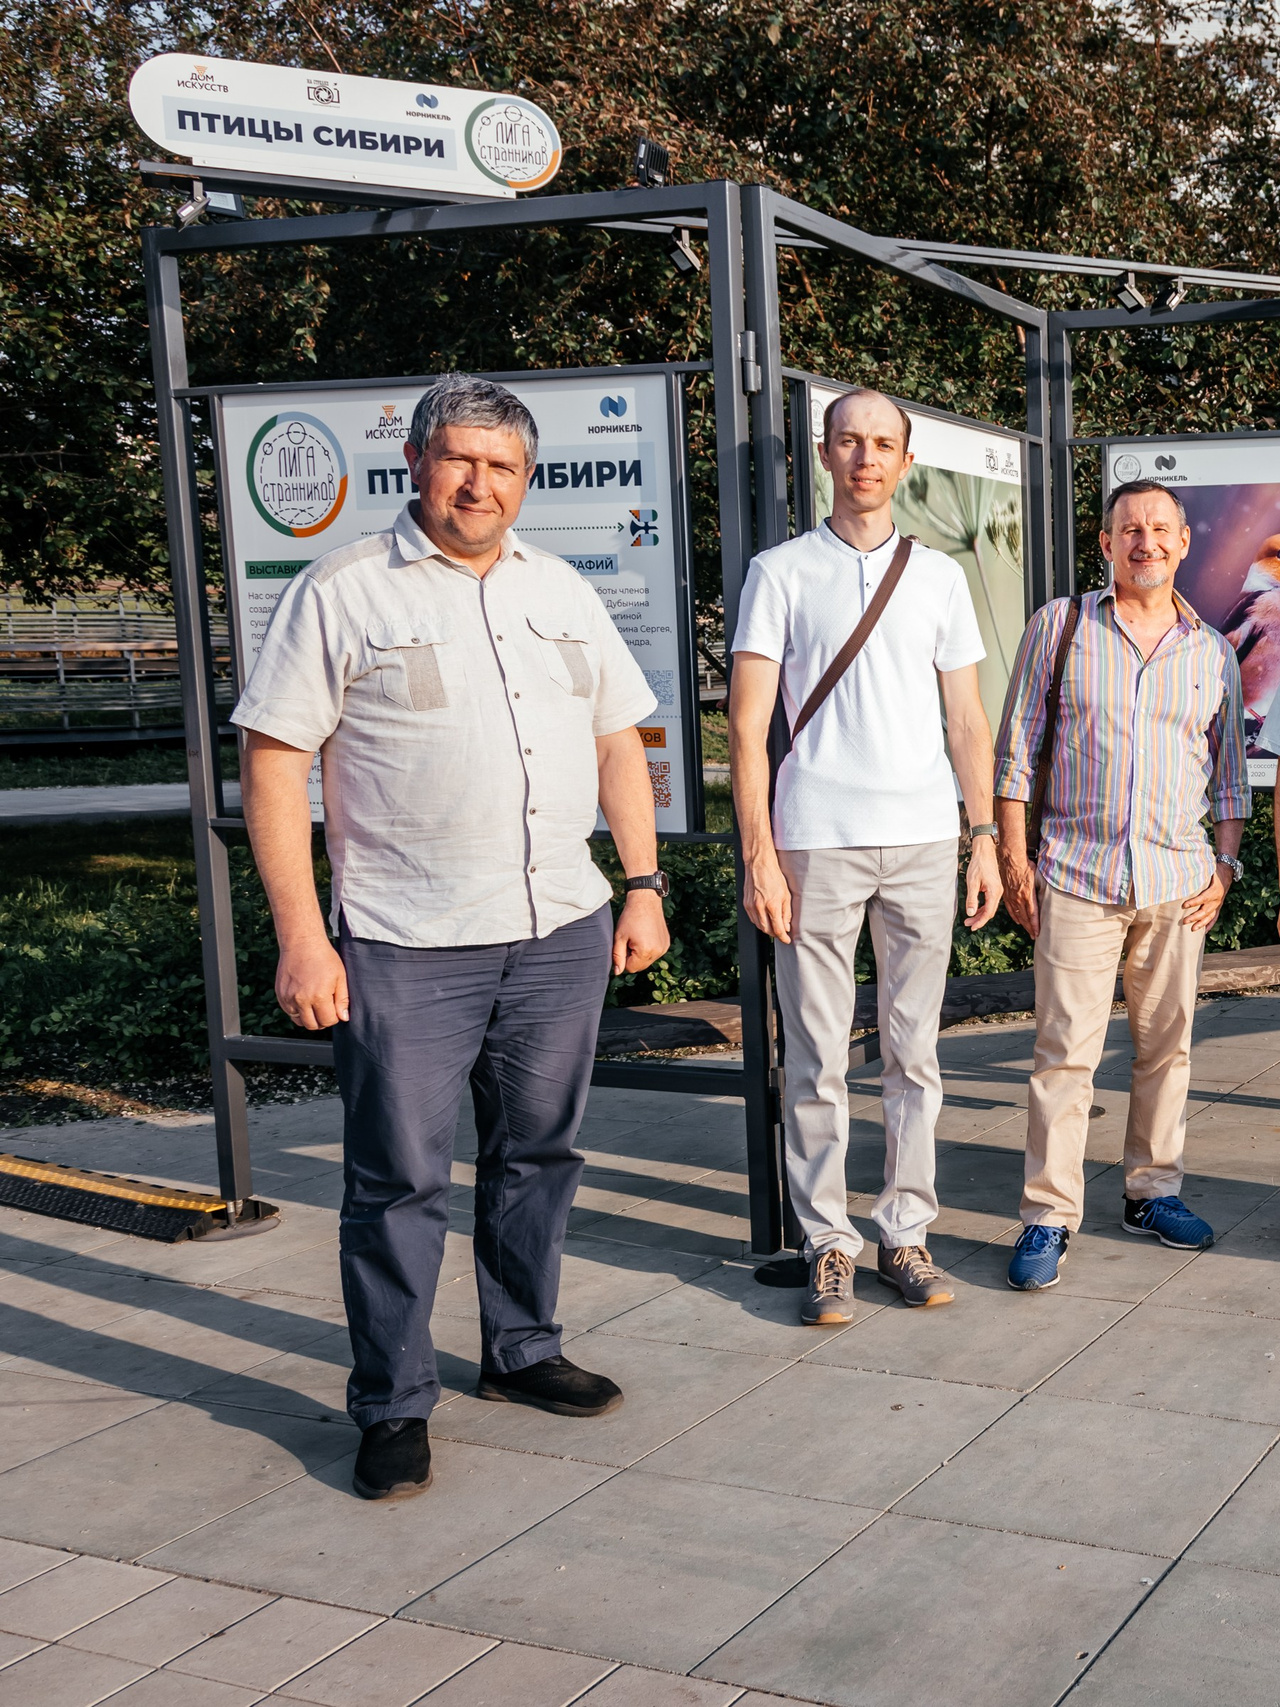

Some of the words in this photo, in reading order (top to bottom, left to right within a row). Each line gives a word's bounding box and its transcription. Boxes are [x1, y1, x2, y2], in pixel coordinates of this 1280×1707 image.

[190, 73, 215, 82] ДОМ
[177, 80, 229, 93] ИСКУССТВ
[406, 110, 451, 121] НОРНИКЕЛЬ
[177, 109, 303, 143] ПТИЦЫ
[313, 125, 445, 158] СИБИРИ
[495, 121, 531, 147] ЛИГА
[378, 416, 402, 428] ДОМ
[365, 428, 412, 440] ИСКУССТ
[588, 424, 642, 434] НОРНИКЕЛЬ
[279, 446, 316, 477] ЛИГА
[529, 459, 642, 490] ИБИРИ
[567, 557, 614, 570] РАФИЙ
[248, 592, 263, 600] Нас
[249, 606, 274, 614] созда
[606, 600, 650, 608] Дубынина
[640, 625, 672, 634] Сергея,
